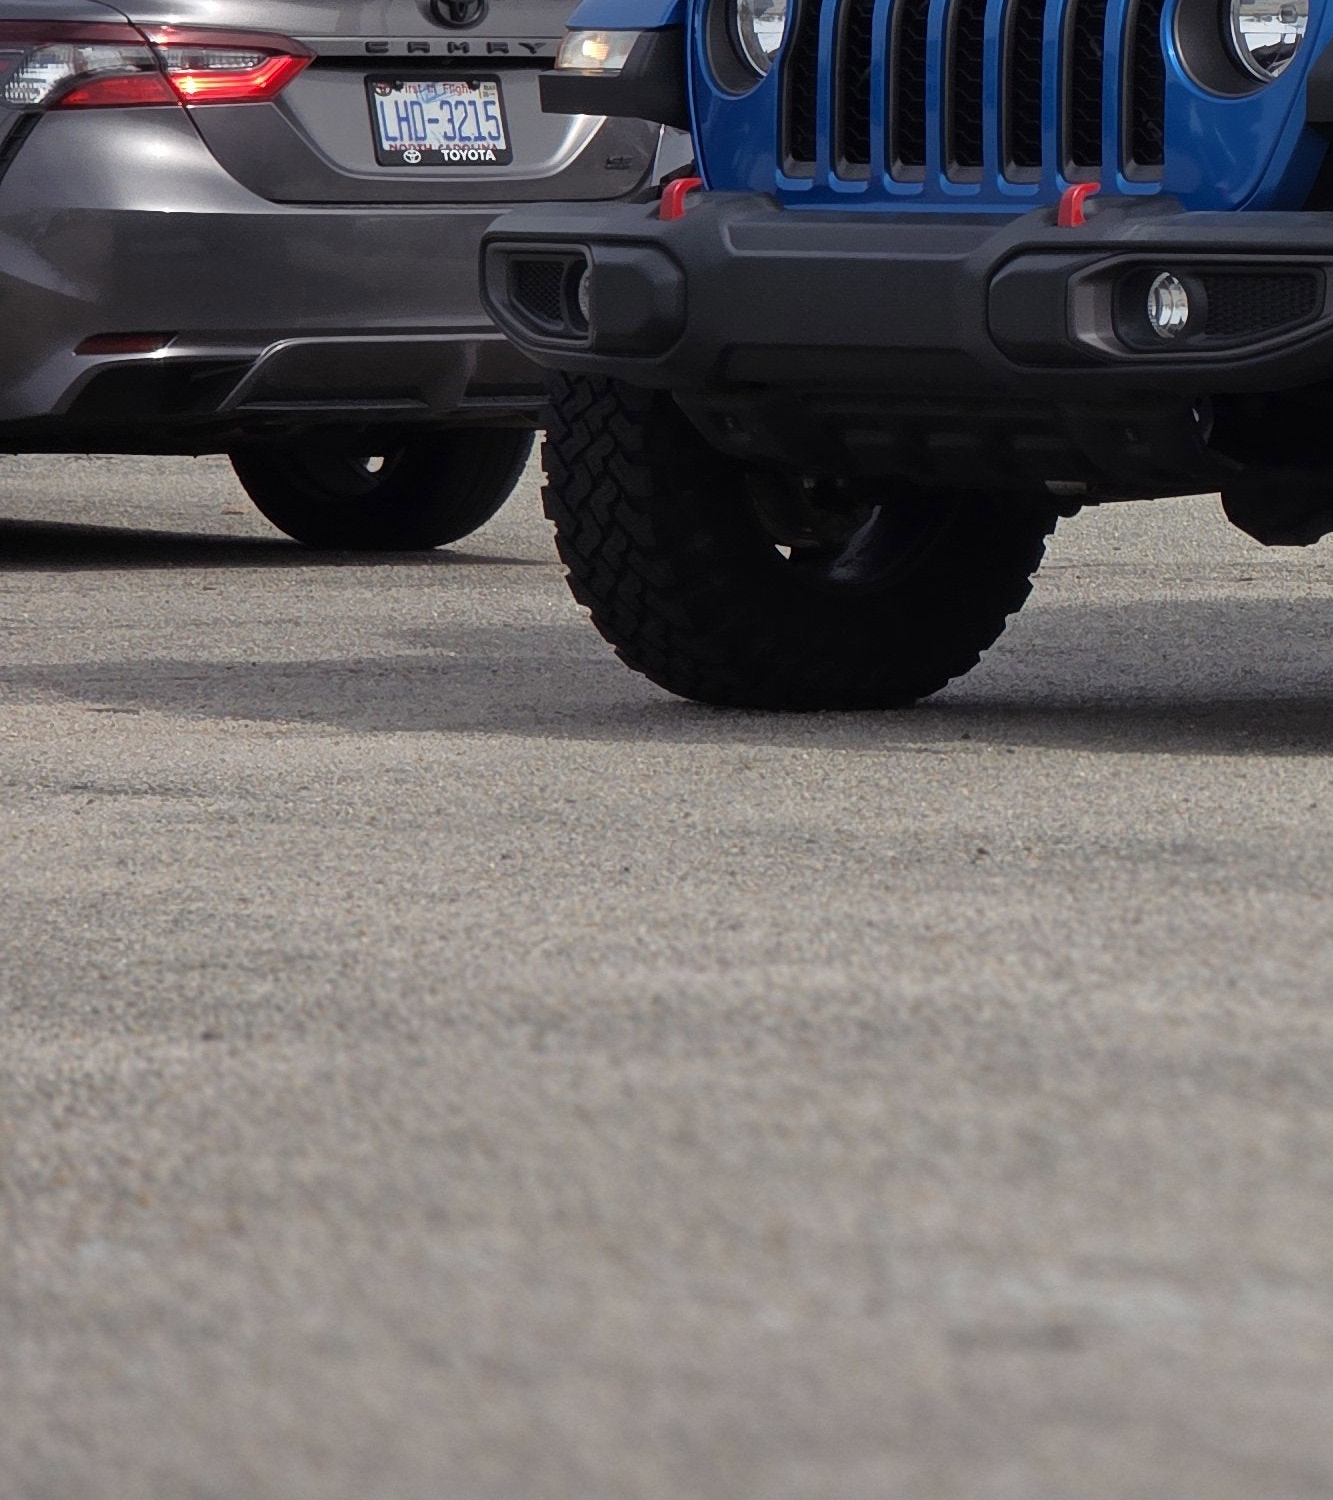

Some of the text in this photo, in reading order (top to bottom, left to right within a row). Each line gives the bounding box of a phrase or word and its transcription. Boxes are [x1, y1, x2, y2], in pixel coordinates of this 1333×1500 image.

[365, 41, 547, 54] CAMRY
[402, 83, 421, 94] irst
[379, 99, 501, 142] LHD-3215
[441, 150, 497, 161] TOYOTA
